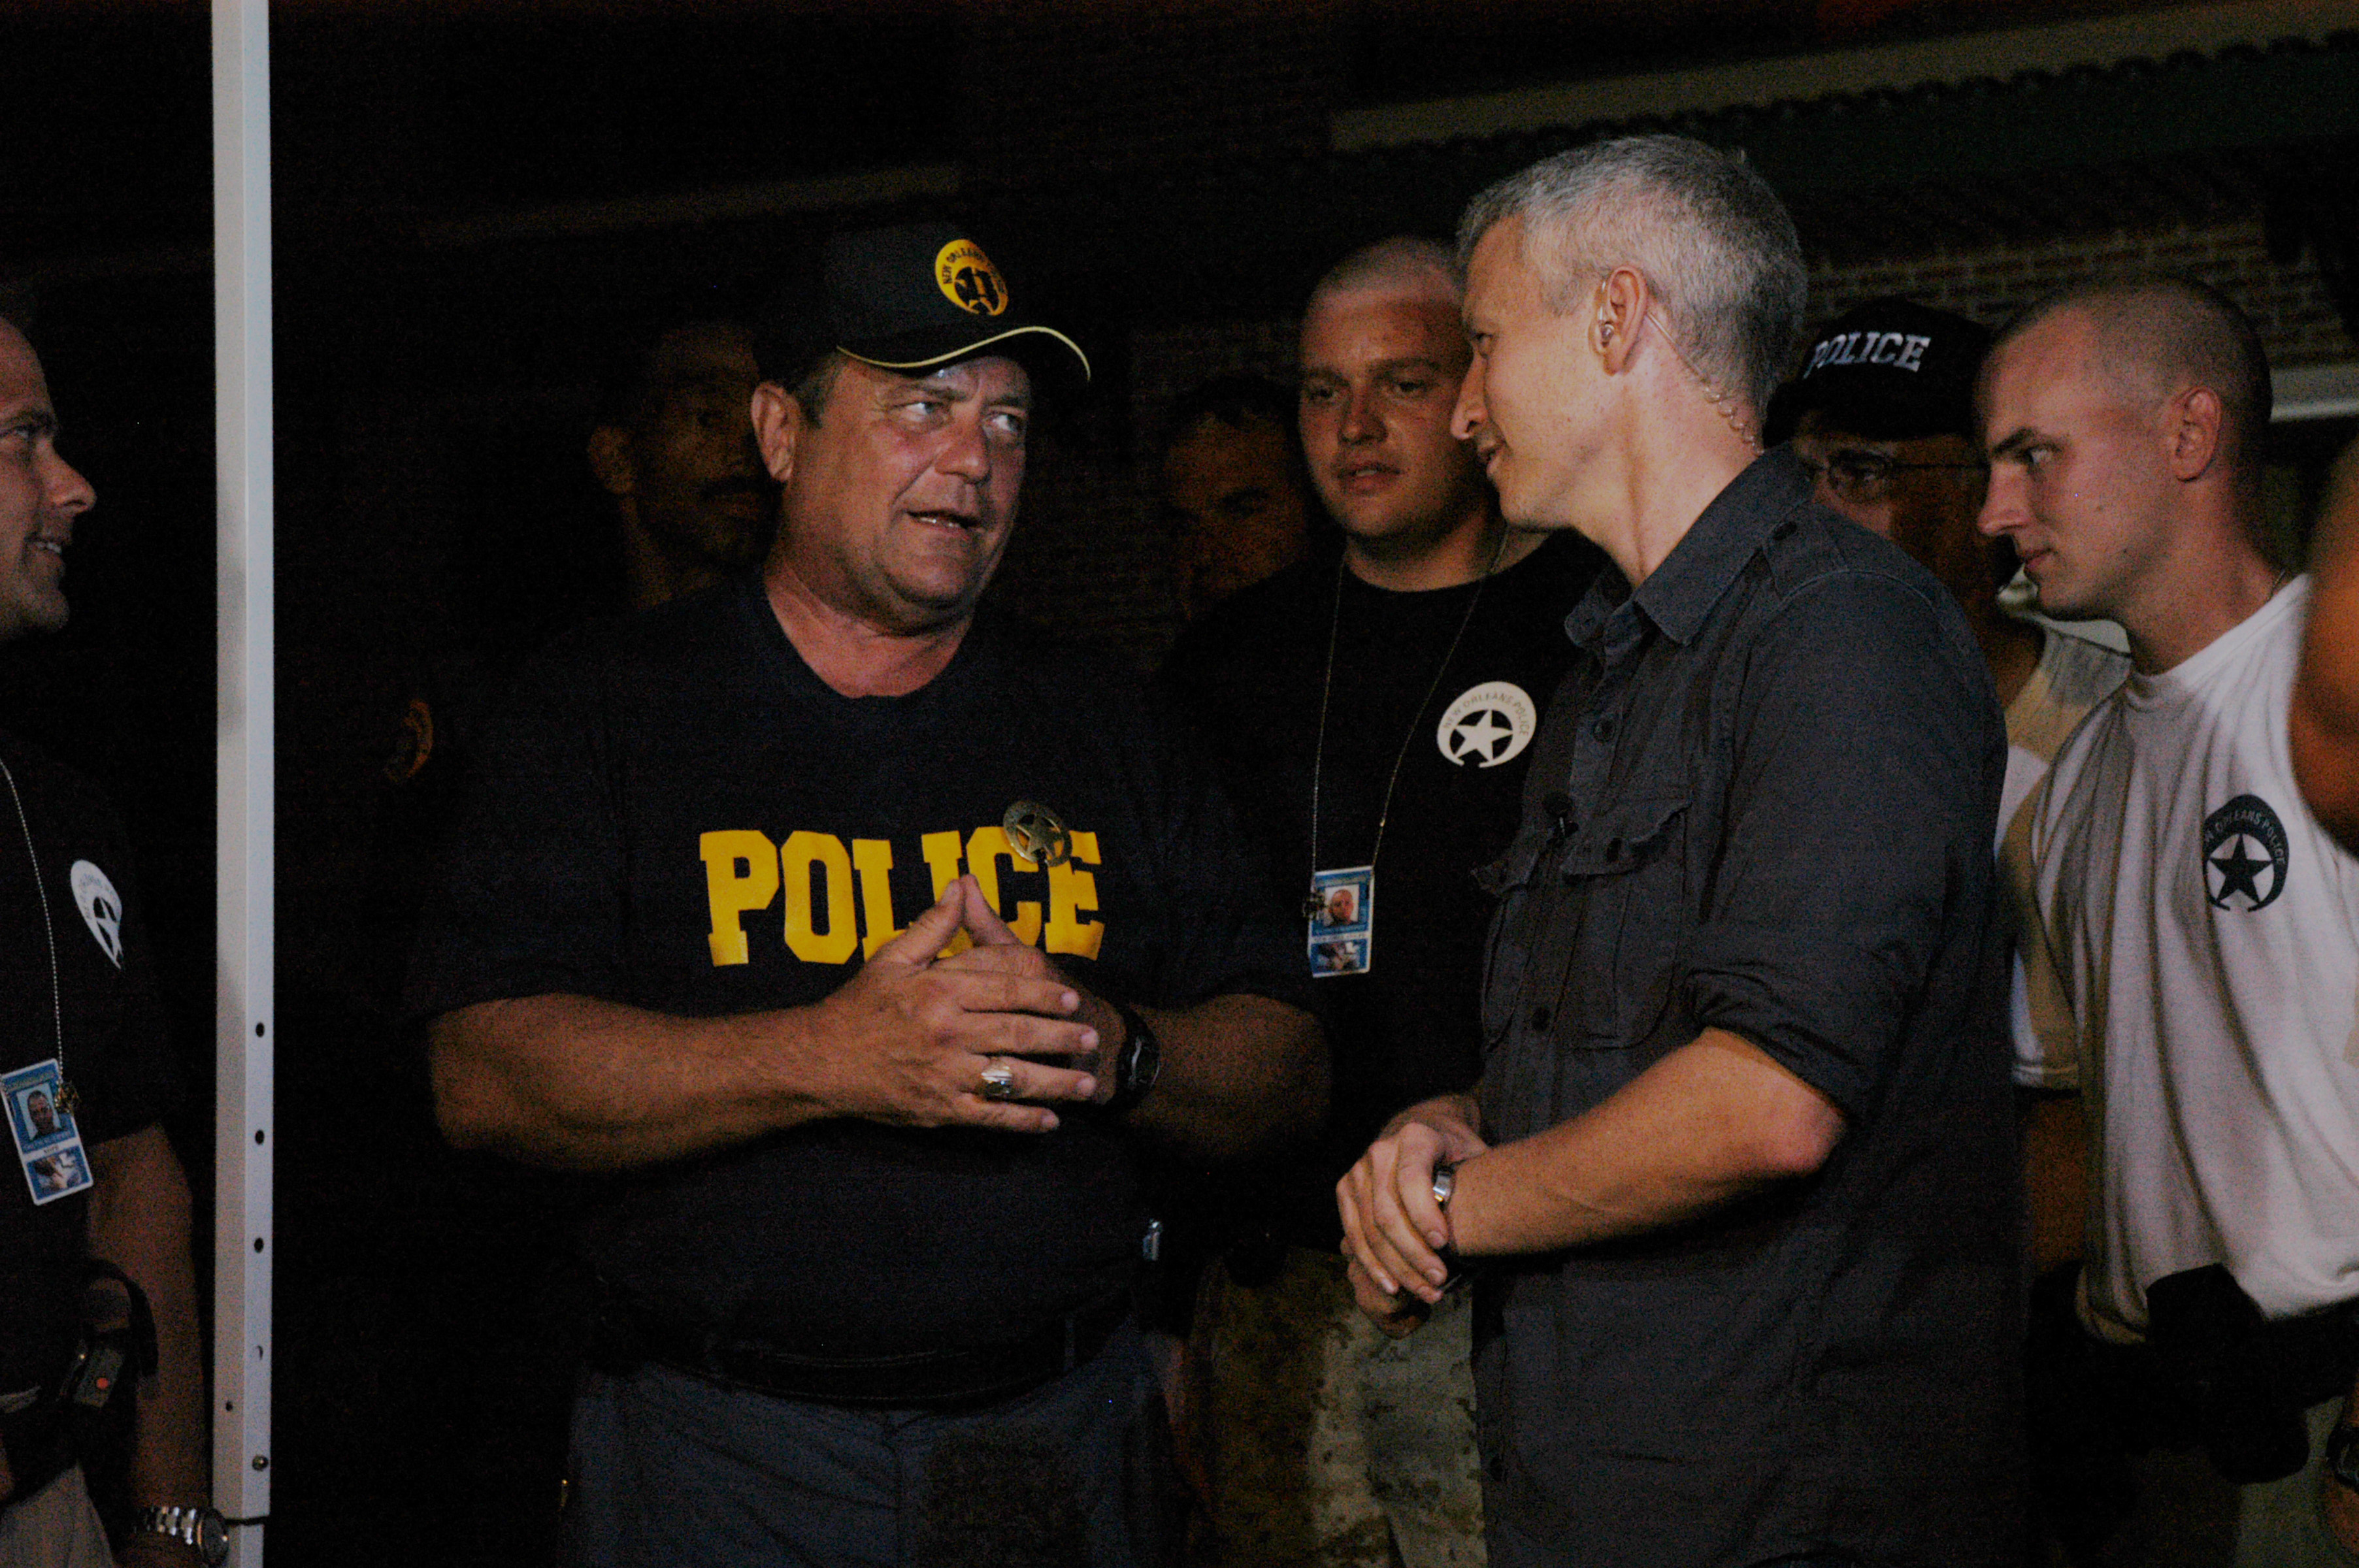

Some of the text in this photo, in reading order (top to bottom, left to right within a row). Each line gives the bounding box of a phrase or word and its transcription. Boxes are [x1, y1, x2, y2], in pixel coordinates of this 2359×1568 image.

[942, 264, 953, 284] NEW
[1802, 331, 1932, 380] POLICE
[1443, 692, 1530, 736] NEW ORLEANS POLICE
[2260, 818, 2286, 865] POLICE
[699, 826, 1105, 967] POLICE
